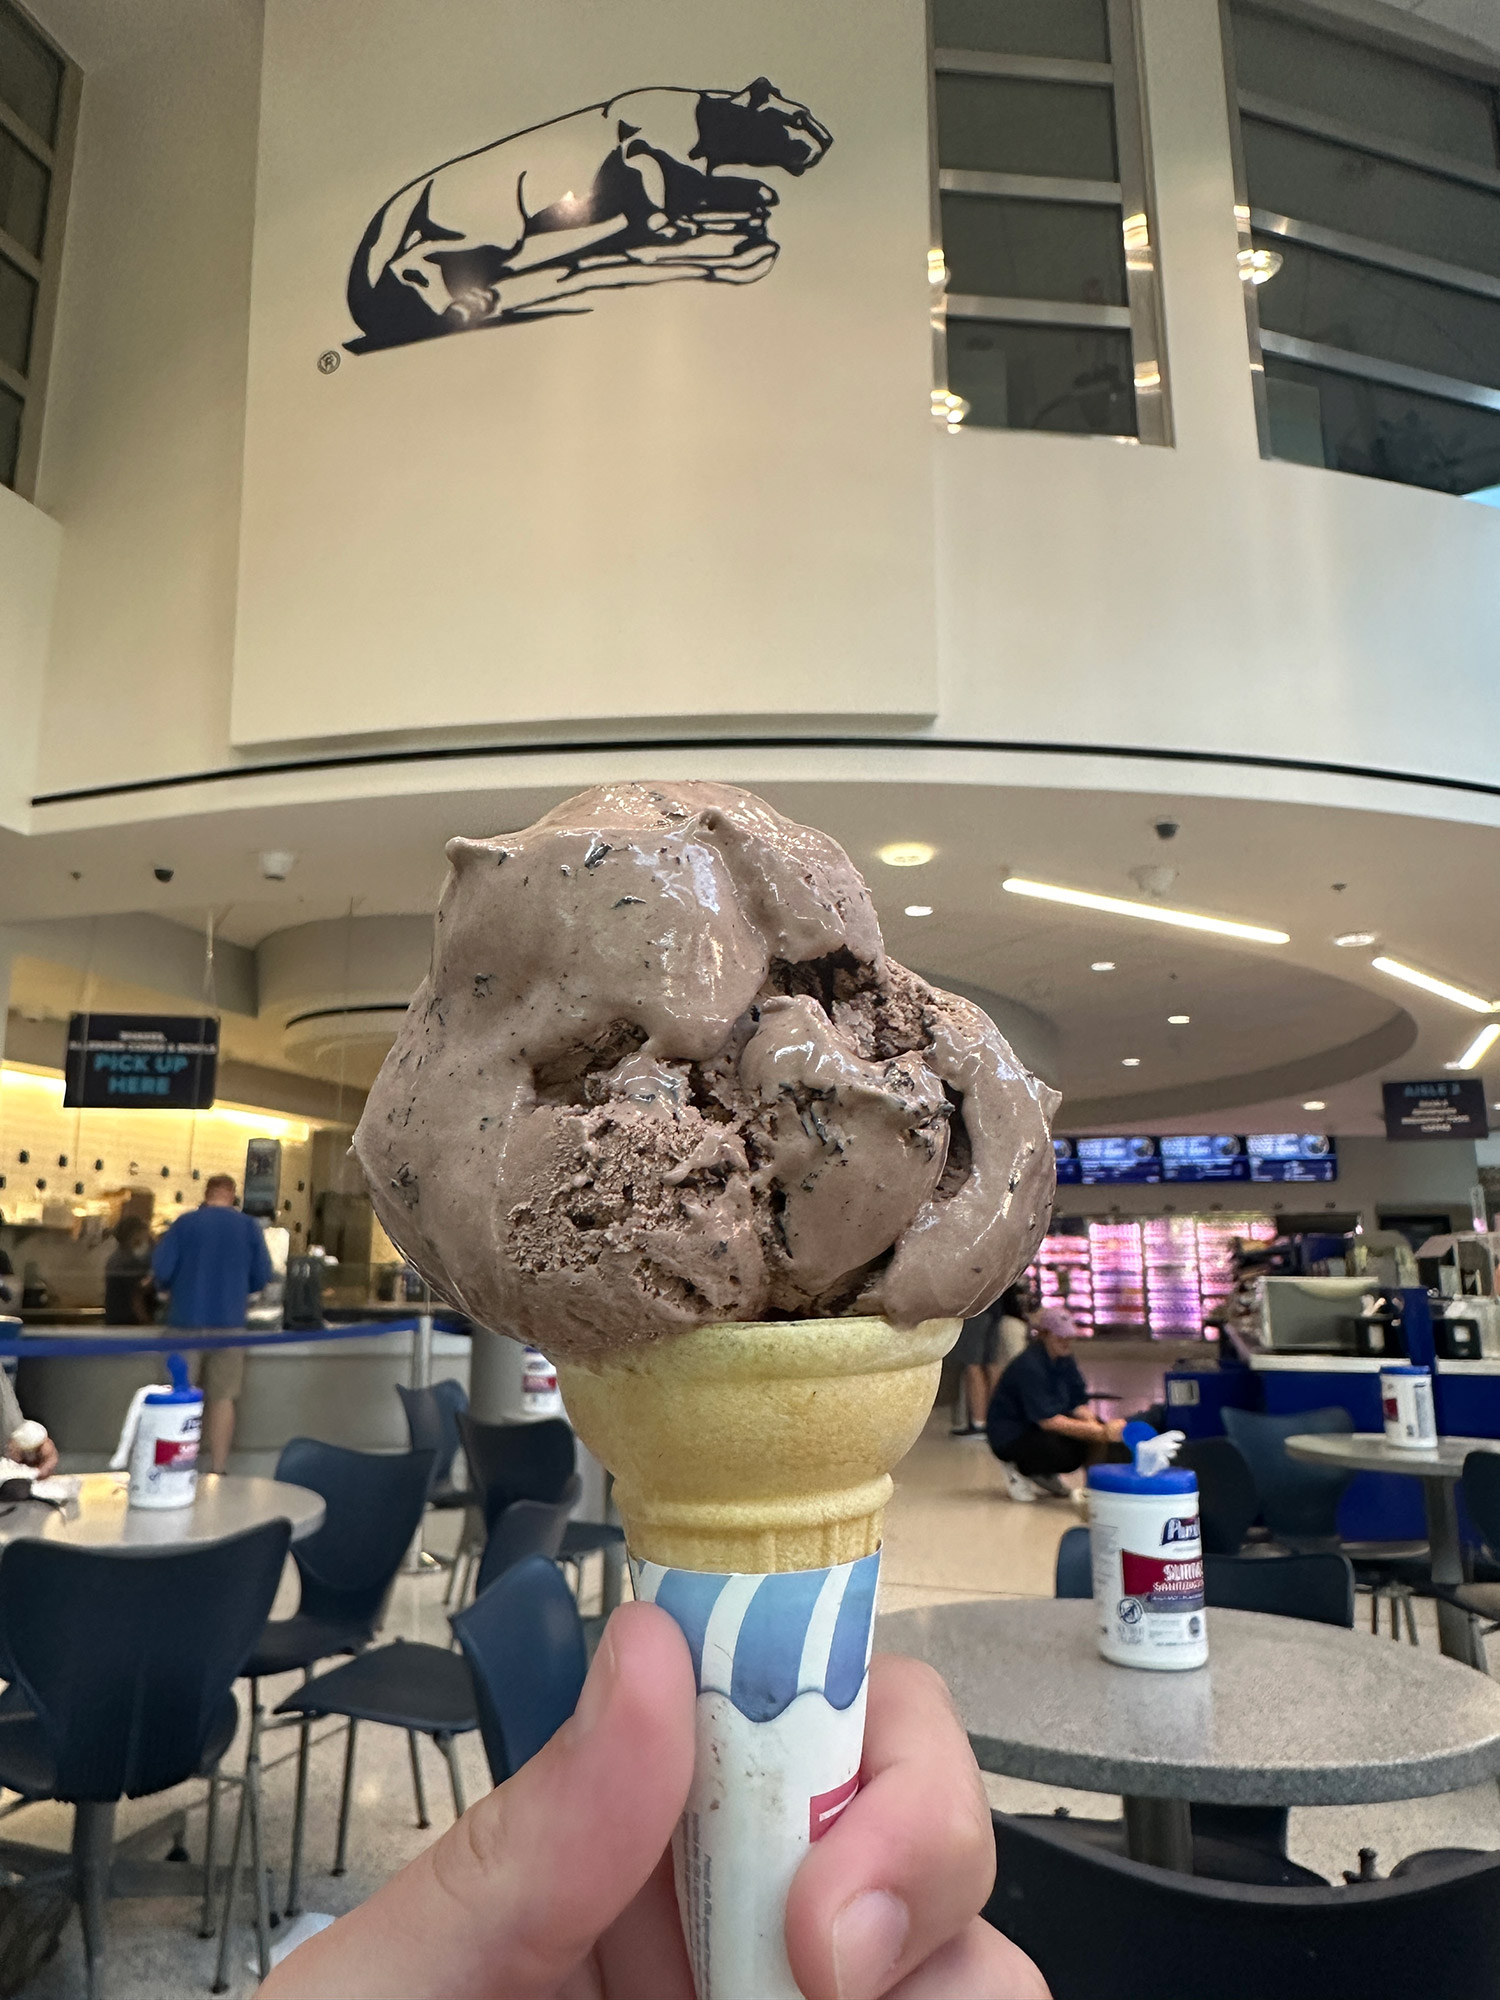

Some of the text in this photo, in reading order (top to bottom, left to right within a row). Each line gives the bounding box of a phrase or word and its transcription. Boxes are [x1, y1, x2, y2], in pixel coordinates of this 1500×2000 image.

[93, 1053, 189, 1073] PICK UP
[107, 1076, 171, 1095] HERE
